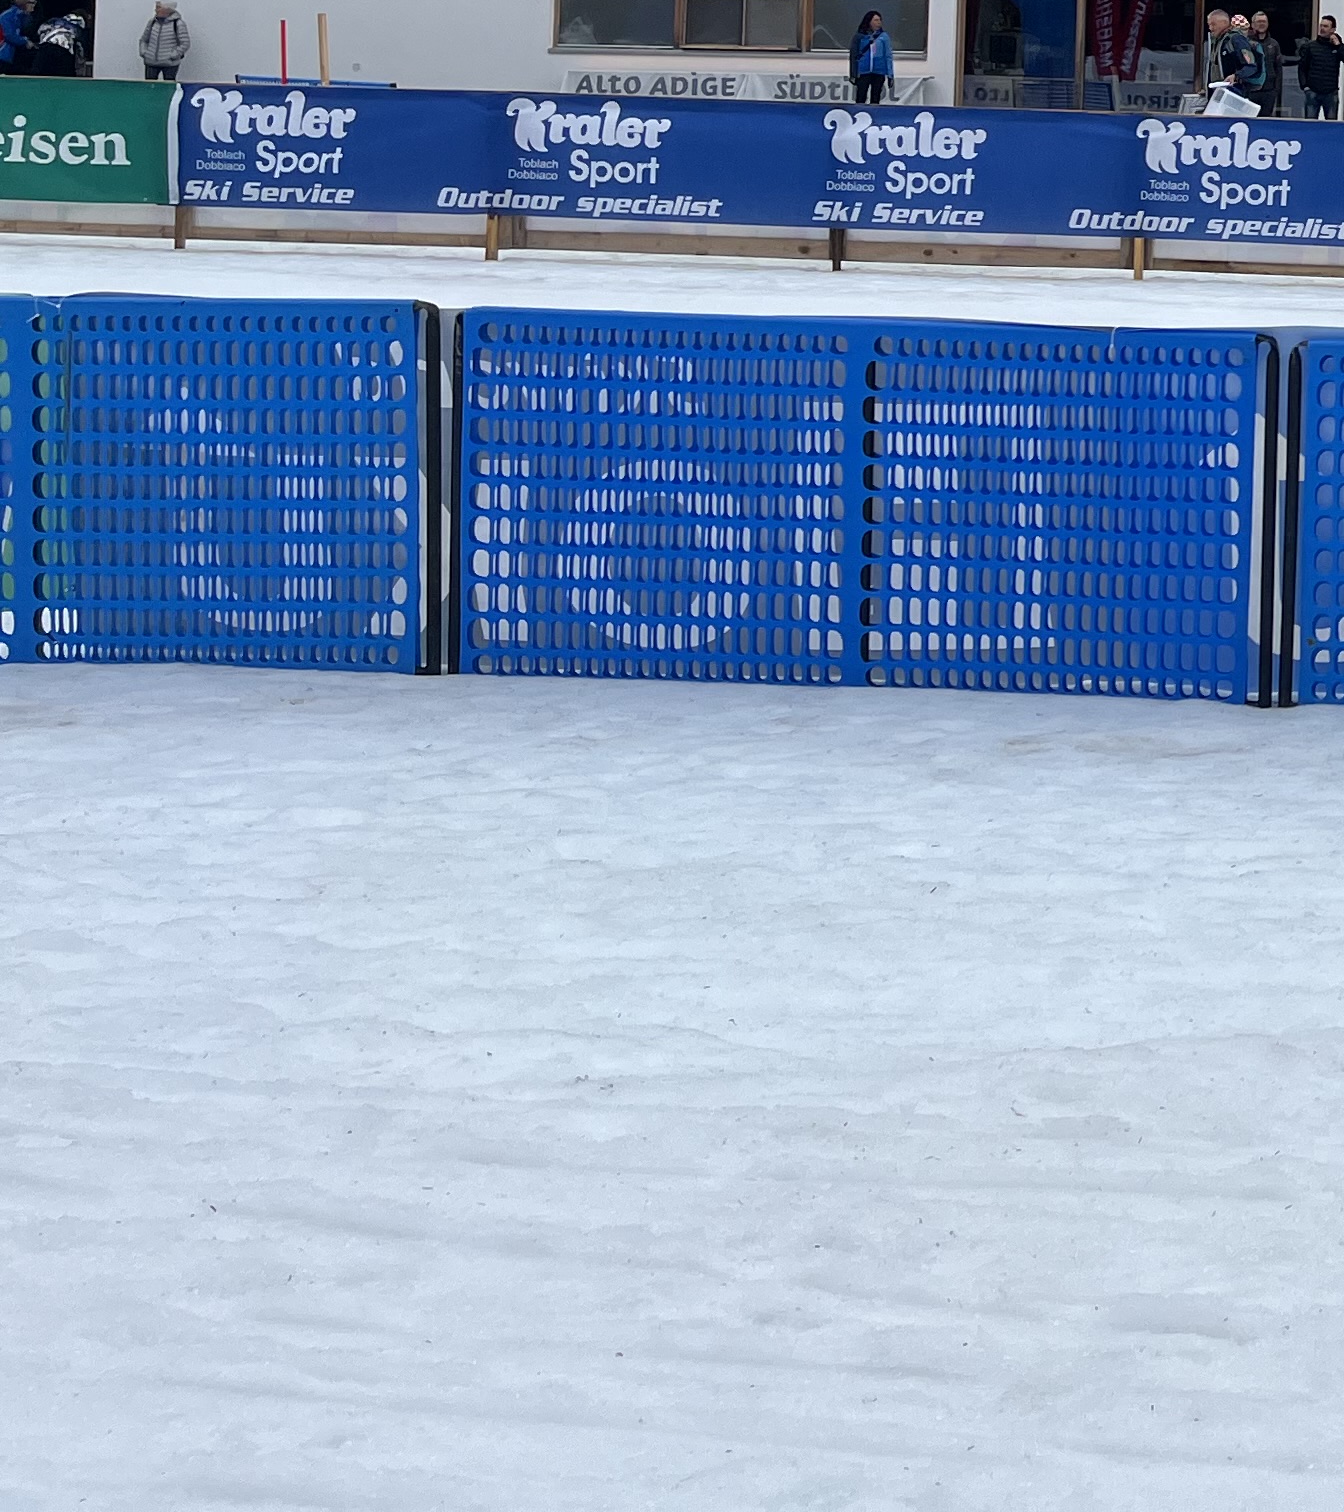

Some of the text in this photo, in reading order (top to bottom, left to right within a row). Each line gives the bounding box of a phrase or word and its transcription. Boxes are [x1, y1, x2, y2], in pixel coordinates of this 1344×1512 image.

[190, 87, 357, 143] Kraler
[506, 97, 671, 153] Kraler
[0, 114, 131, 166] isen
[824, 108, 987, 164] Kraler
[1136, 118, 1301, 174] Kraler
[196, 160, 246, 172] Dobbiaco
[205, 148, 246, 160] Toblach
[256, 140, 343, 178] Sport
[518, 157, 559, 169] Toblach
[507, 168, 558, 180] Dobbiaco
[568, 149, 660, 188] Sport
[835, 169, 875, 181] Toblach
[885, 160, 976, 199] Sport
[183, 179, 355, 204] Ski Service
[826, 180, 875, 192] Dobbiaco
[1140, 190, 1189, 202] Dobbiaco
[1149, 179, 1190, 191] Toblach
[1199, 171, 1291, 210] Sport
[437, 186, 723, 218] Outdoor specialist
[811, 201, 985, 226] Ski Service
[1068, 208, 1195, 233] Outdoor
